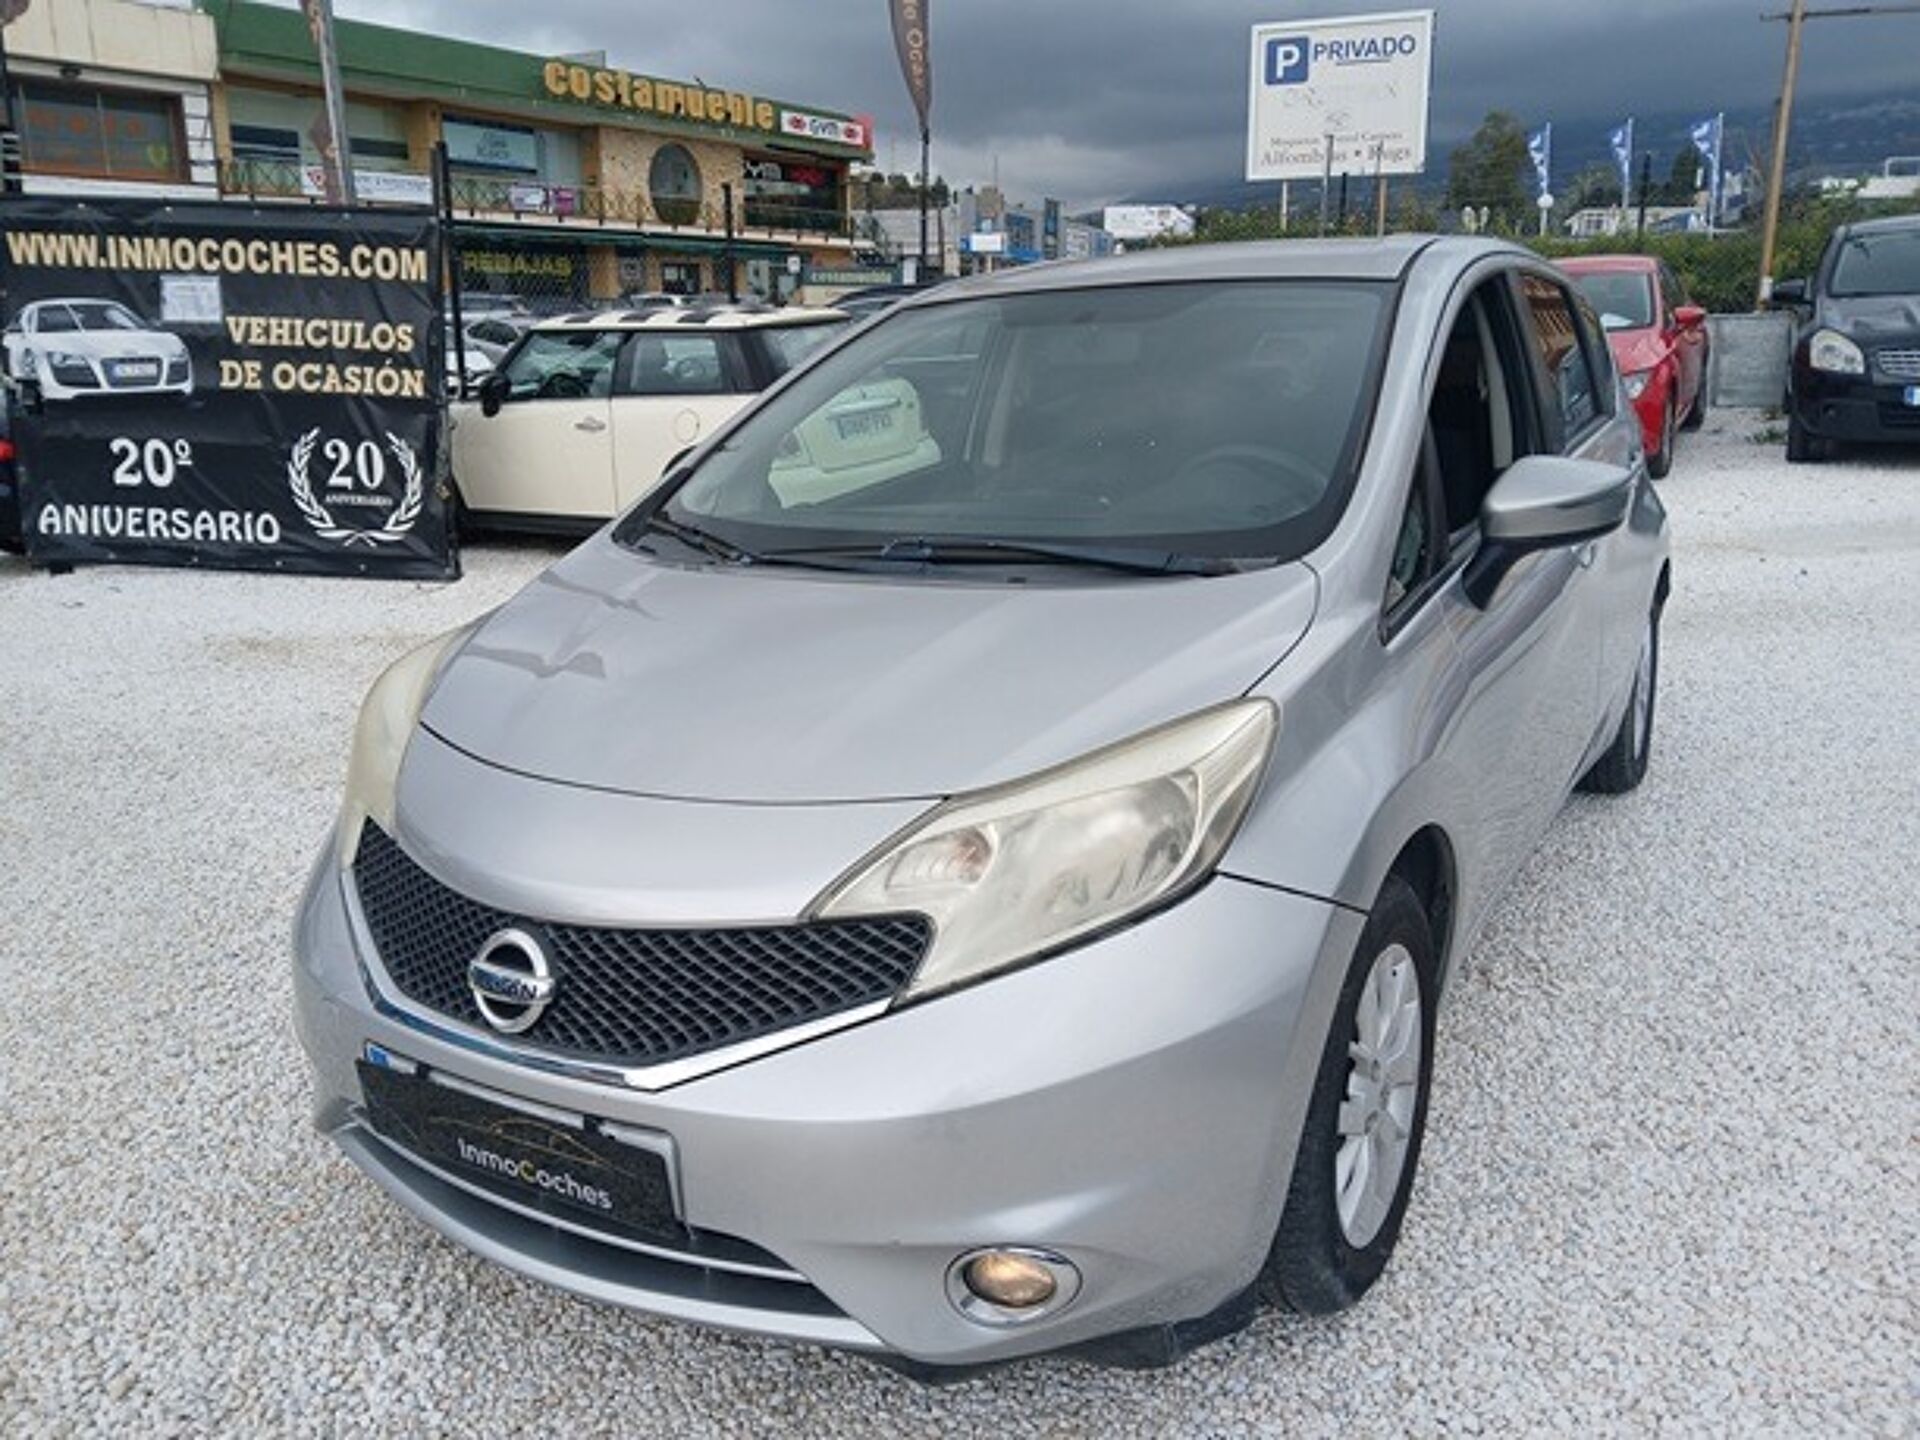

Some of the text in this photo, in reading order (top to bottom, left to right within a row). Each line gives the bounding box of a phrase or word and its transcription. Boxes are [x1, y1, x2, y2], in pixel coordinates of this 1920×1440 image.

[1276, 34, 1417, 79] P PRIVADO
[543, 60, 776, 131] costamueble
[6, 231, 428, 283] WWW.INMOCOCHES.COM
[226, 315, 415, 353] VEHICULOS
[219, 357, 425, 397] DE OCASIÓN
[323, 438, 385, 490] 20
[38, 503, 281, 545] ANIVERSARIO
[457, 1136, 613, 1209] InmoCoches
